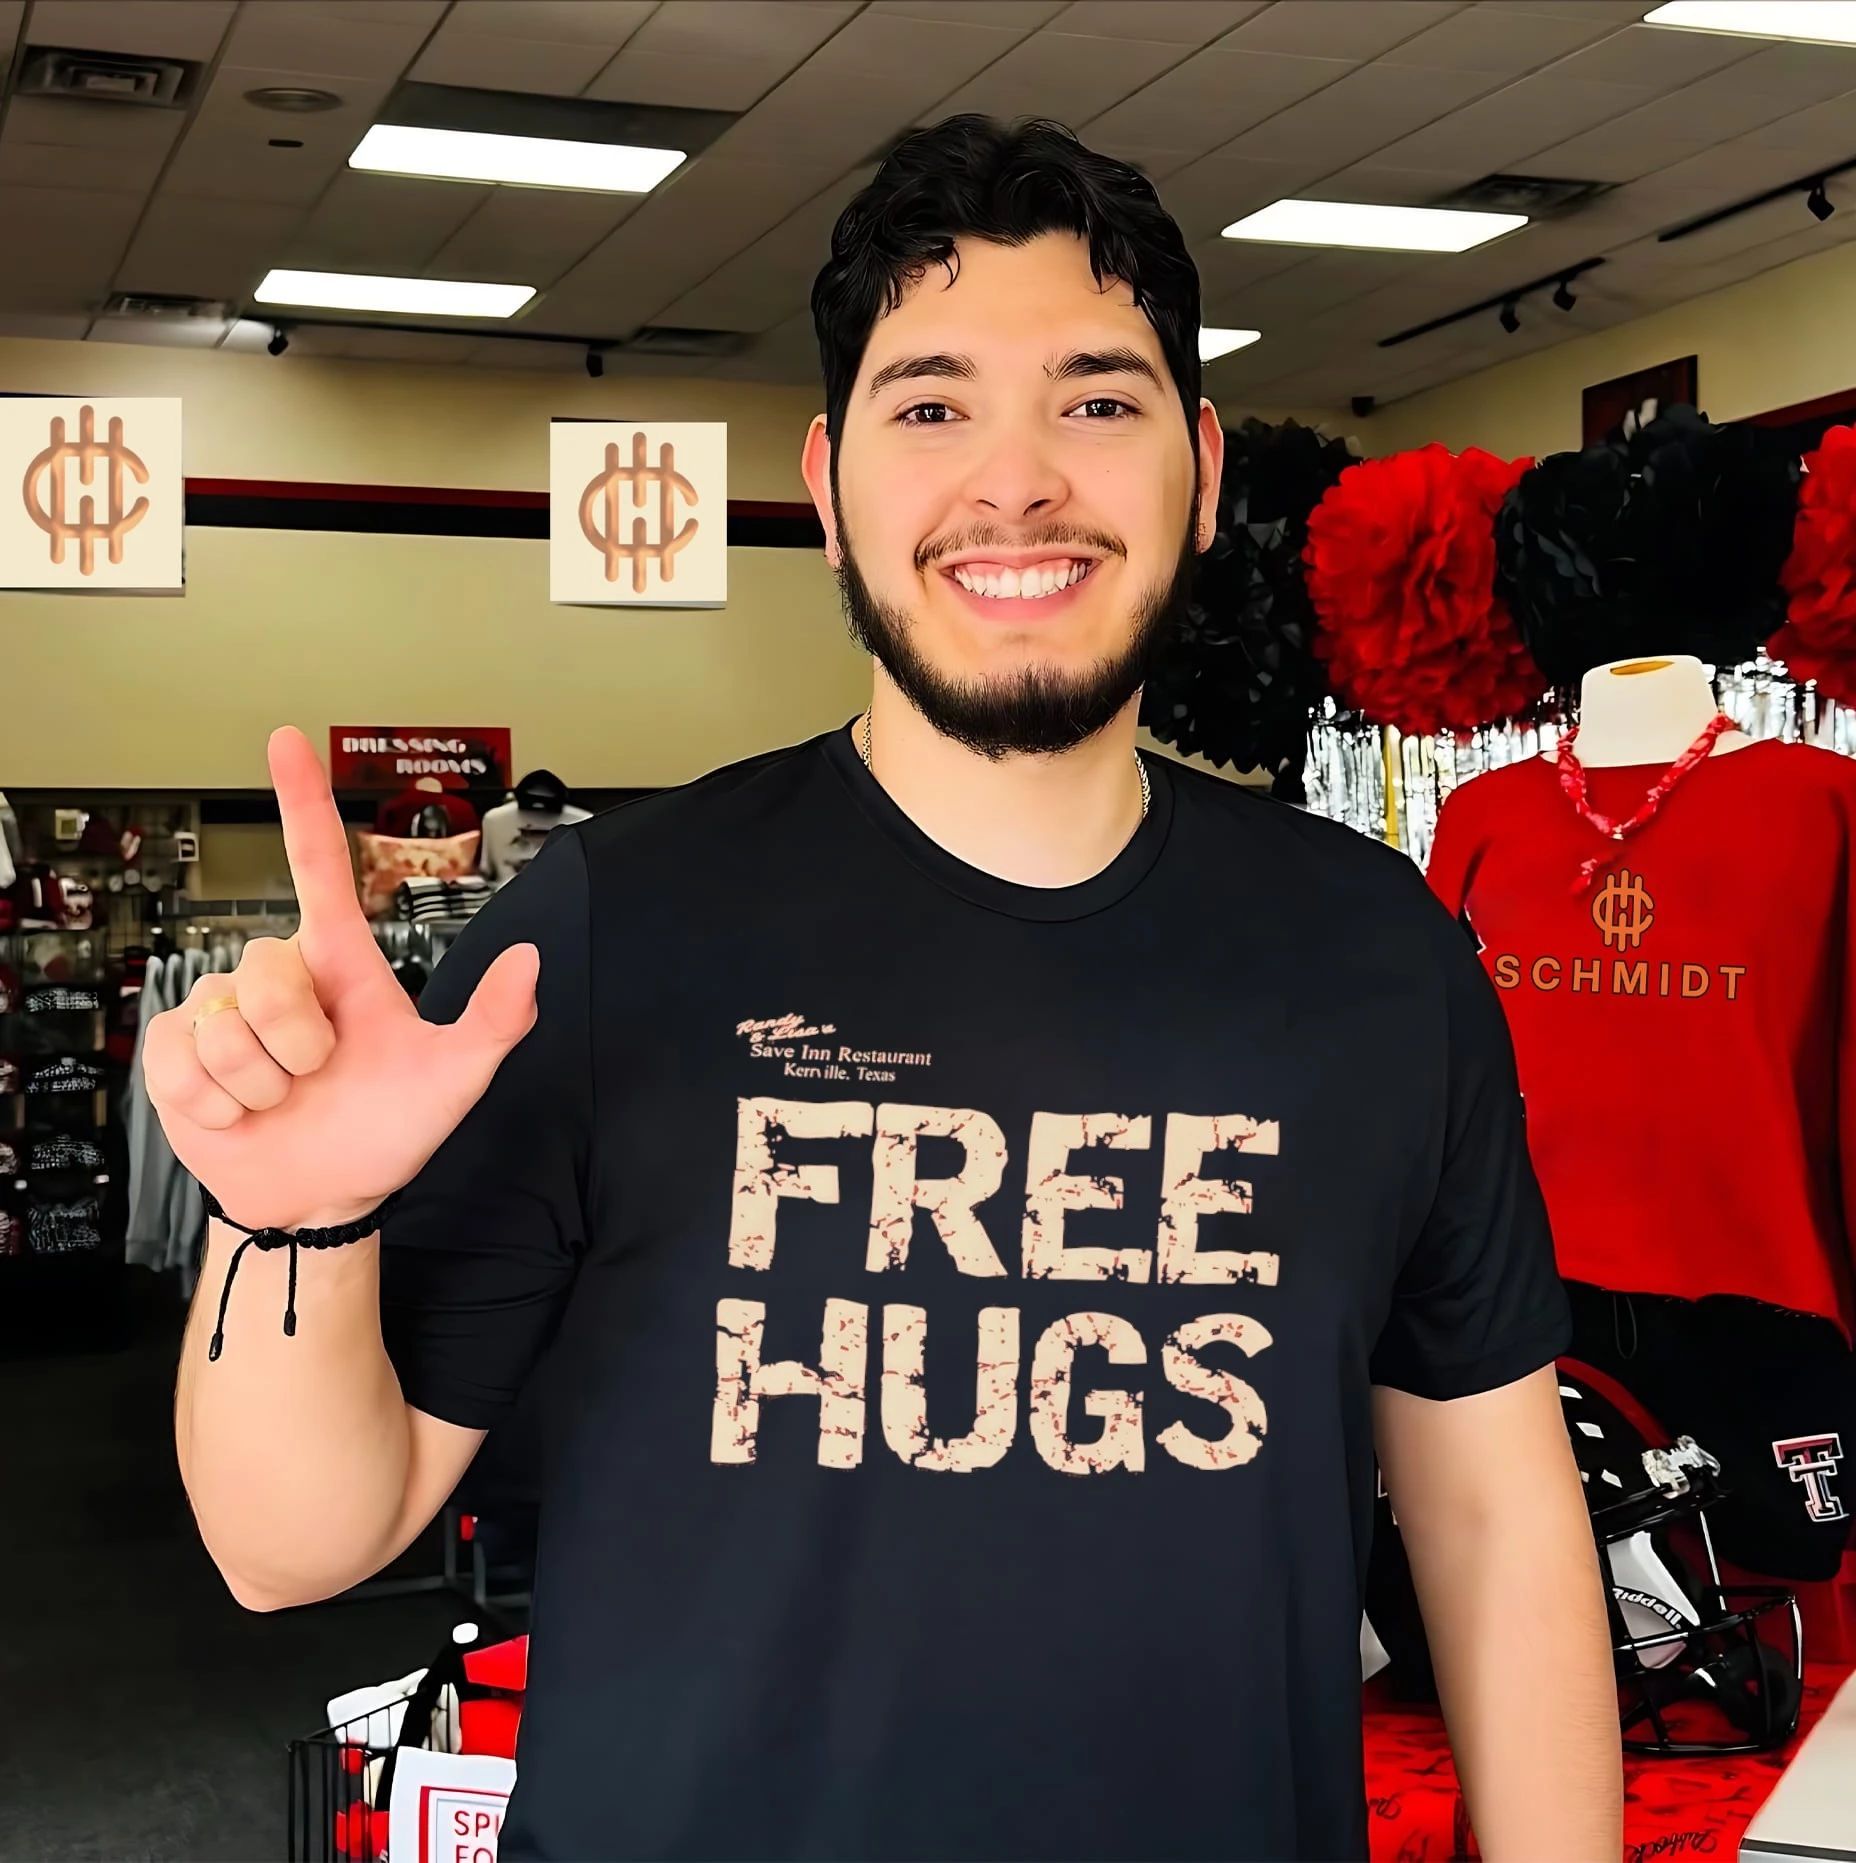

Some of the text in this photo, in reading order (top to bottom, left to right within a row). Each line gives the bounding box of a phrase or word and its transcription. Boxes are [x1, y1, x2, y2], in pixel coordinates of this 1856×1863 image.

[396, 758, 487, 775] ROOMS
[1493, 954, 1747, 1000] SCHMIDT
[736, 1013, 805, 1036] Randy
[750, 1043, 933, 1067] Save Inn Restaurant
[856, 1066, 897, 1082] Texas
[728, 1096, 1281, 1287] FREE
[709, 1297, 1275, 1475] HUGS
